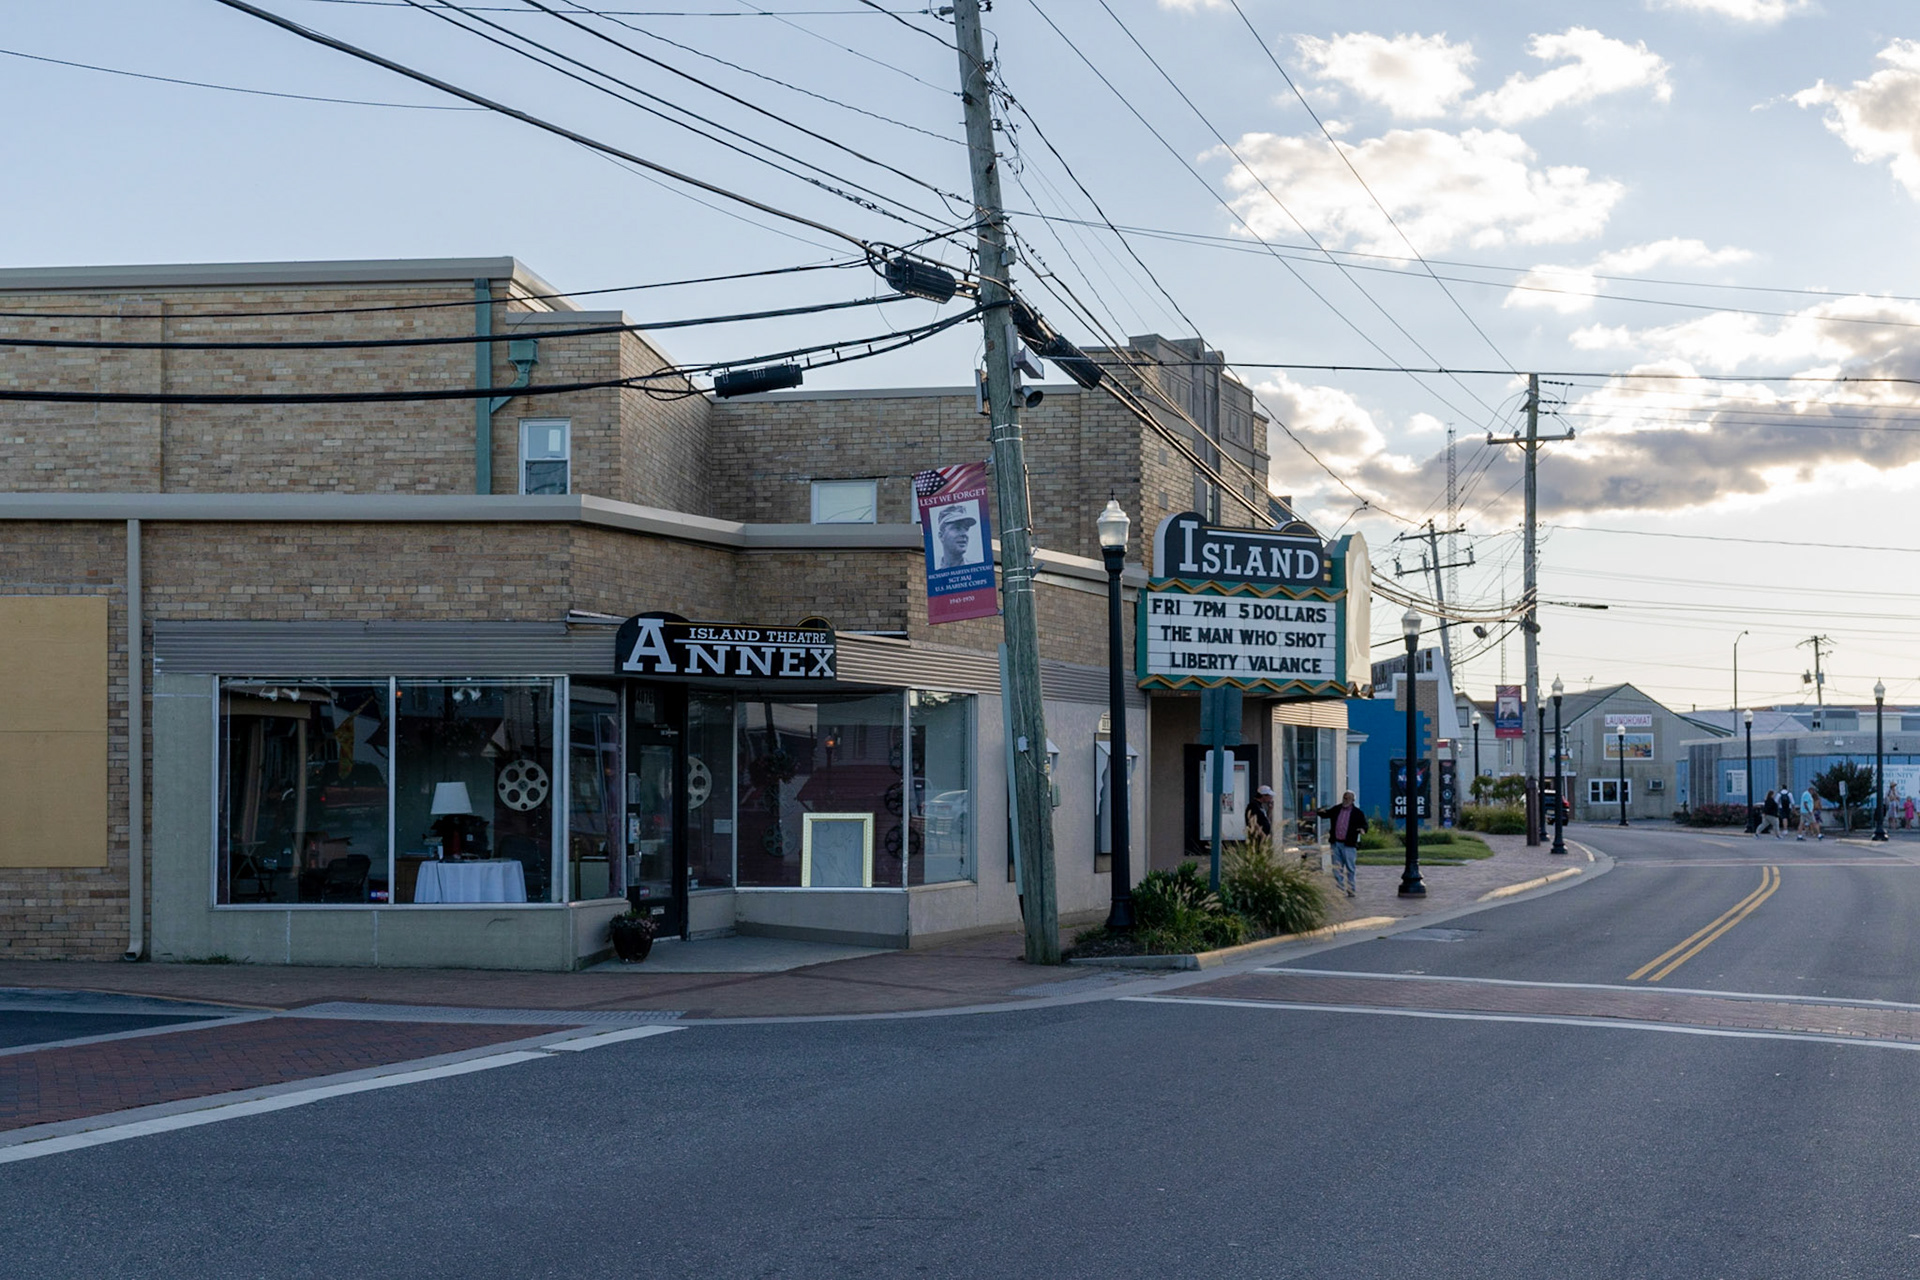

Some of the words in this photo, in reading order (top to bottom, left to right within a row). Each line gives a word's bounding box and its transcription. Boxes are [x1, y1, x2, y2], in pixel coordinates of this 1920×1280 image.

[920, 495, 938, 507] LEST
[939, 493, 952, 503] WE
[953, 487, 986, 502] FORGET
[1178, 519, 1320, 580] ISLAND
[945, 582, 968, 591] MARINE
[968, 579, 987, 587] CORPS
[1152, 598, 1181, 615] FRI
[1193, 601, 1226, 618] 7PM
[689, 627, 761, 641] ISLAND
[766, 630, 827, 644] THEATRE
[1161, 625, 1192, 642] THE
[1198, 627, 1233, 644] MAN
[1239, 629, 1278, 646] WHO
[1285, 632, 1327, 648] SHOT
[622, 618, 834, 678] ANNEX
[1171, 652, 1239, 670] LIBERTY
[1248, 655, 1322, 674] VALANCE
[1606, 715, 1650, 726] LAUNDROMAT
[1395, 805, 1425, 815] HE
